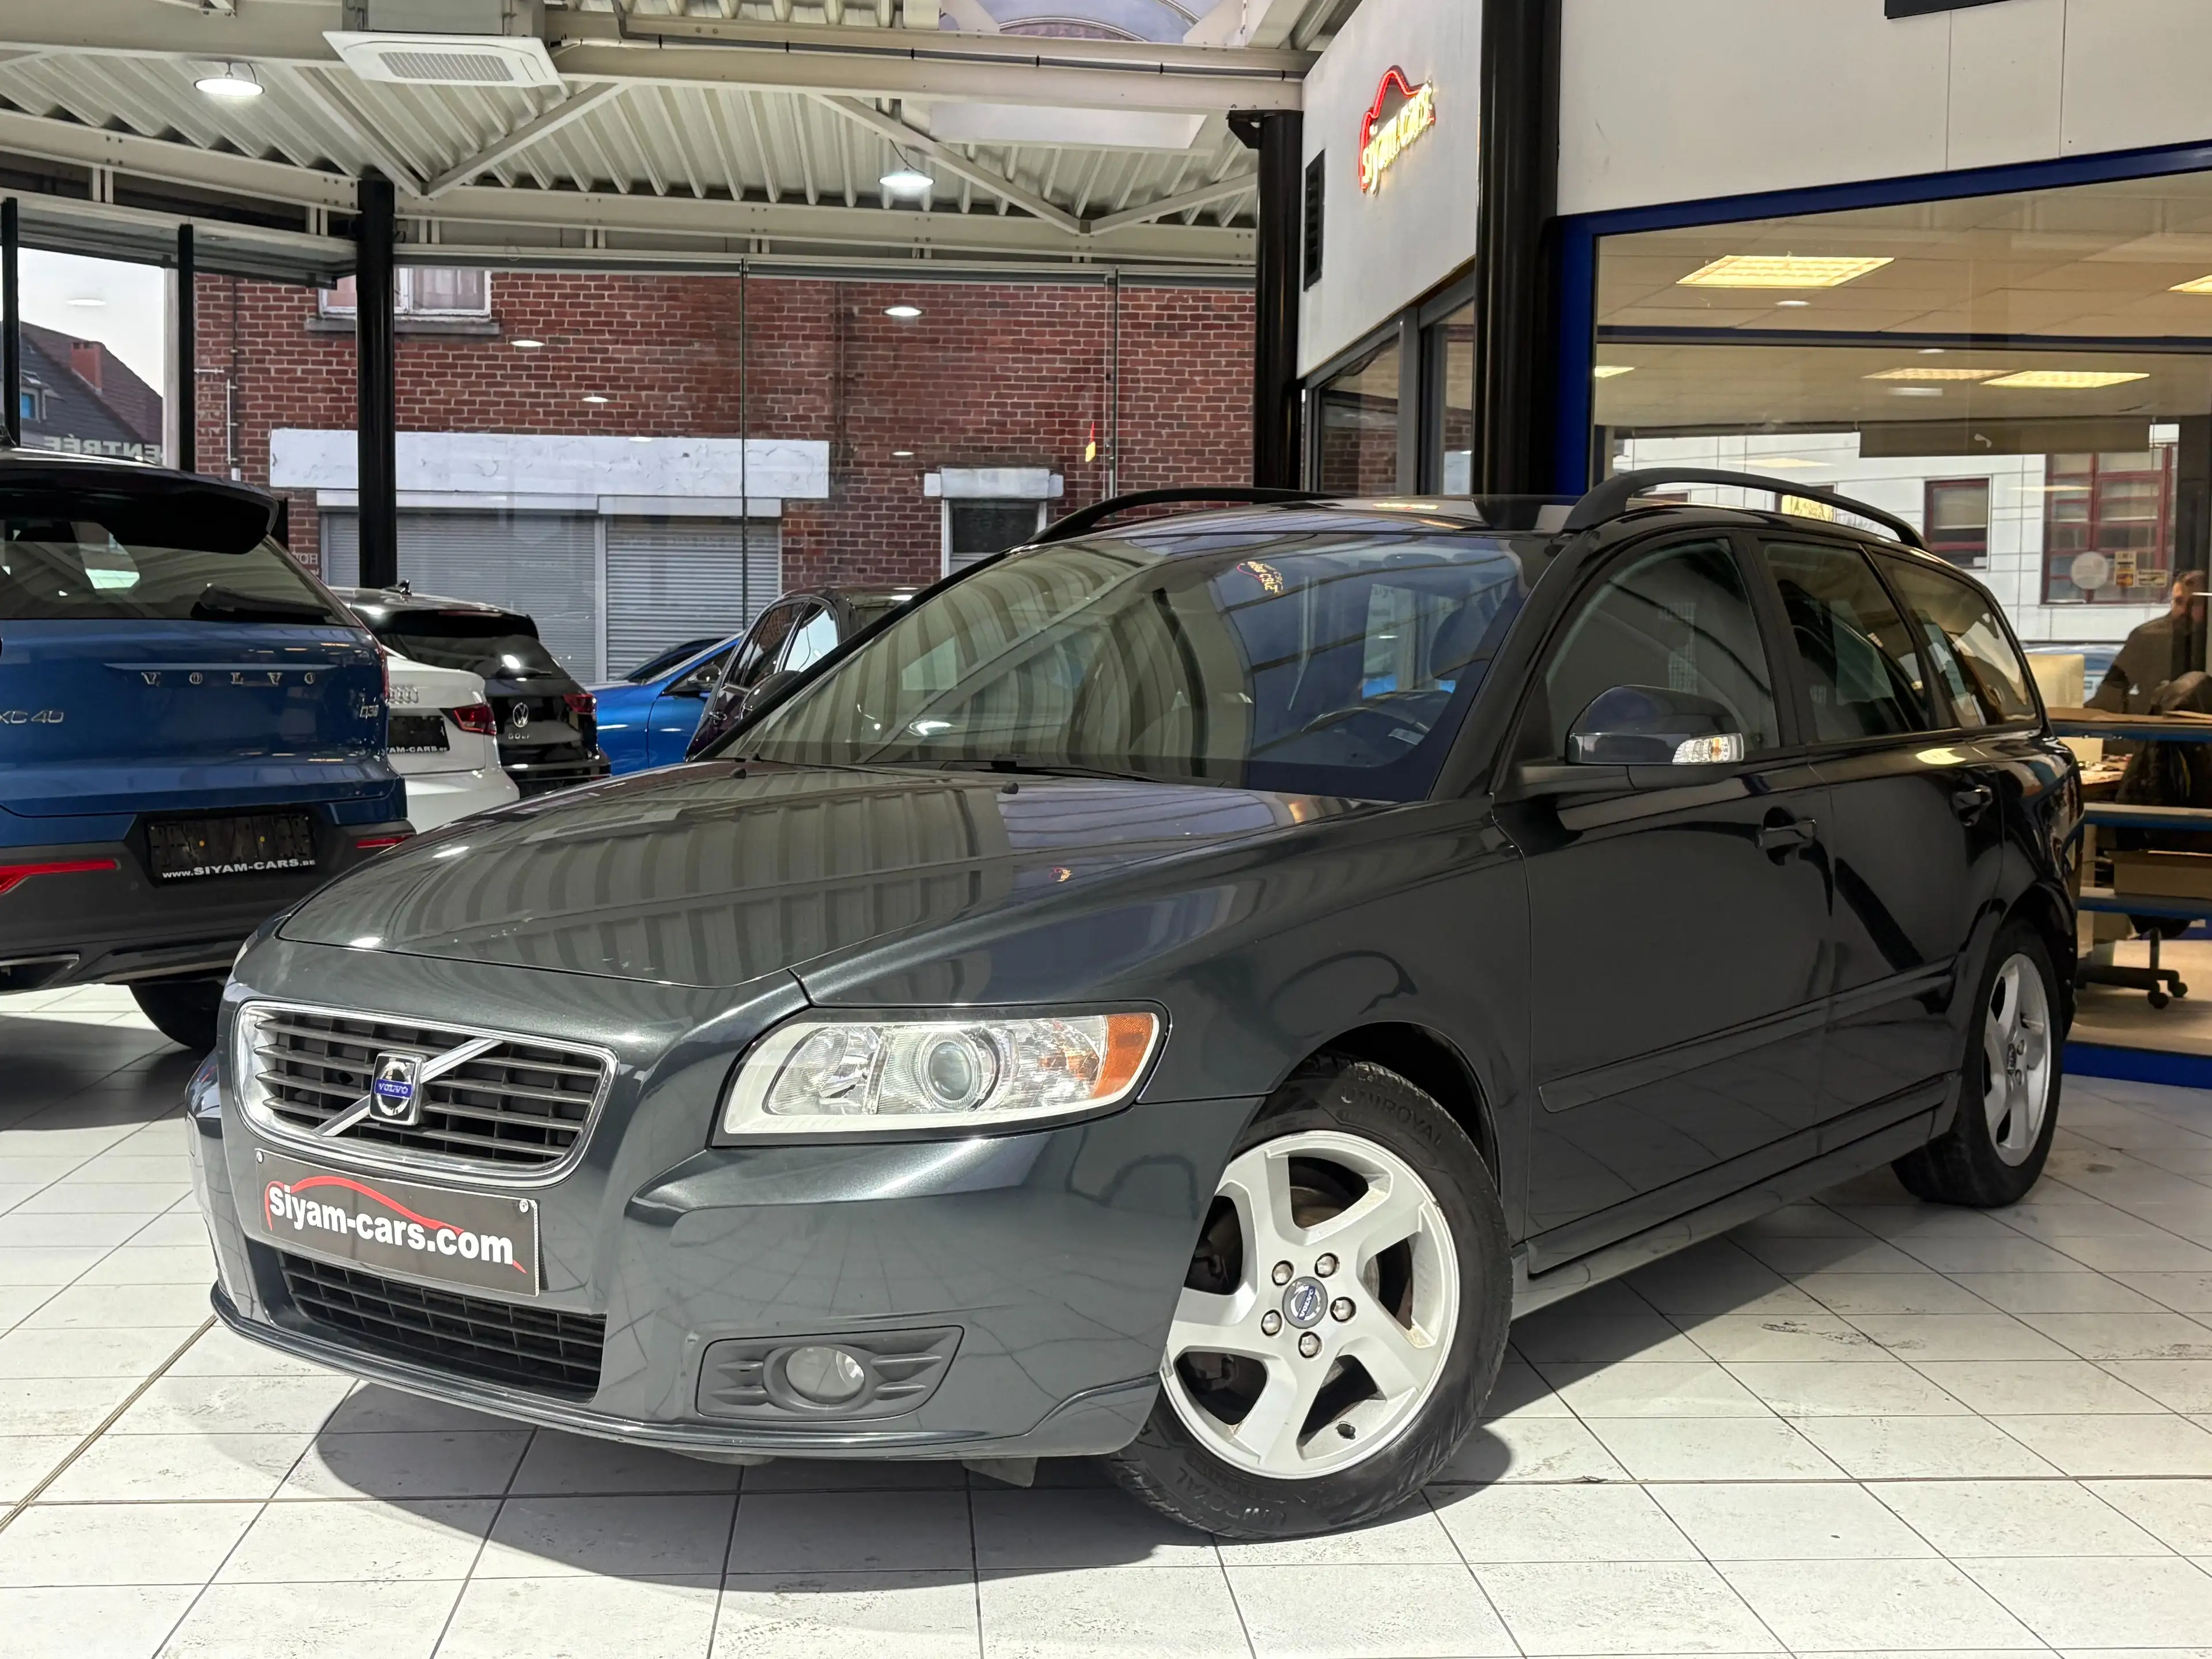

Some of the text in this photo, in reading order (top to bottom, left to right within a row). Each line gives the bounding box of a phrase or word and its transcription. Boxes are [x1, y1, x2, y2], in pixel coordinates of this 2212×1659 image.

[141, 672, 315, 685] VOLVO
[379, 1083, 408, 1094] VOLVO
[1340, 1086, 1443, 1148] UNIROYAL
[1299, 1289, 1313, 1317] VOLVO
